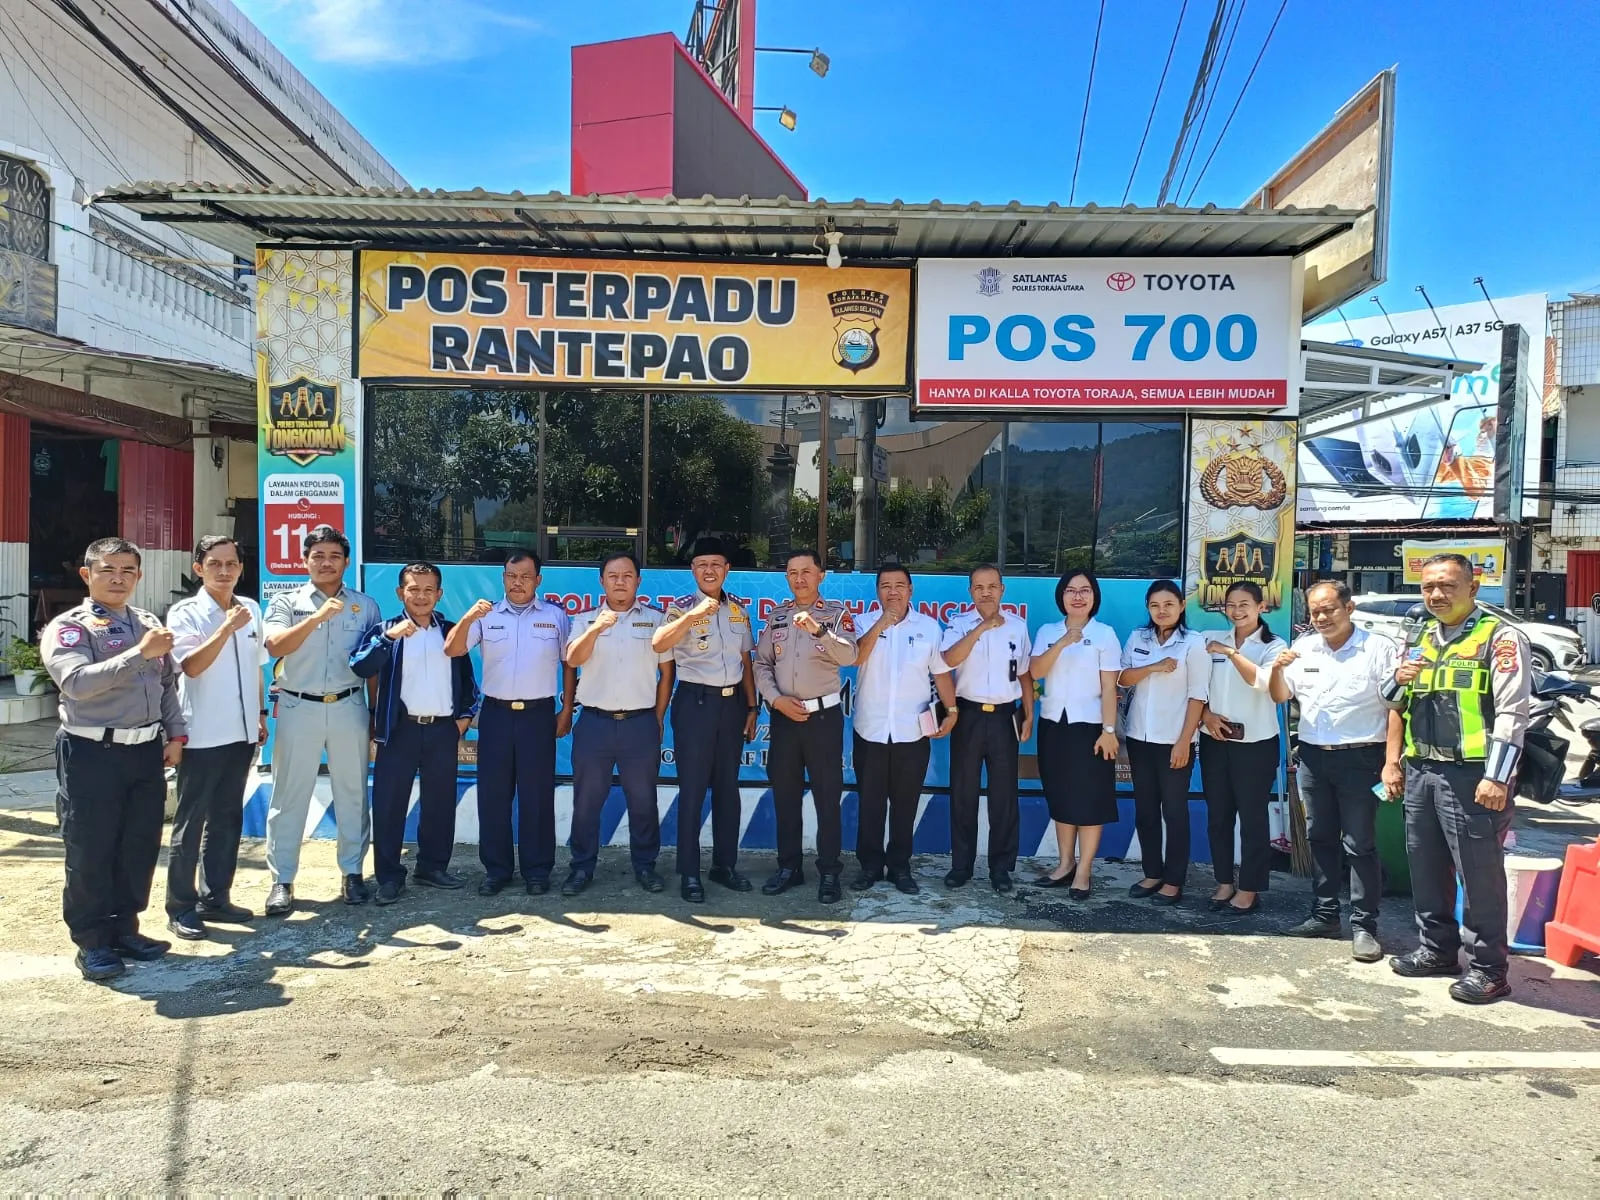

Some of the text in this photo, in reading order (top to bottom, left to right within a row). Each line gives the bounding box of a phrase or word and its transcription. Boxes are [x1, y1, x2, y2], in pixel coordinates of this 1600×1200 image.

[1012, 274, 1067, 283] SATLANTAS
[1144, 274, 1235, 291] TOYOTA
[387, 265, 797, 326] POS TERPADU
[949, 314, 1258, 361] POS 700
[1370, 330, 1421, 347] Galaxy
[1422, 327, 1447, 340] A57
[1455, 323, 1481, 337] A37
[1484, 320, 1505, 333] 5G
[430, 324, 752, 383] RANTEPAO
[929, 388, 1275, 401] HANYA DI KALLA TOYOTA TORAJA, SEMUA LEBIH MUDAH
[262, 424, 344, 450] TONGKONAN
